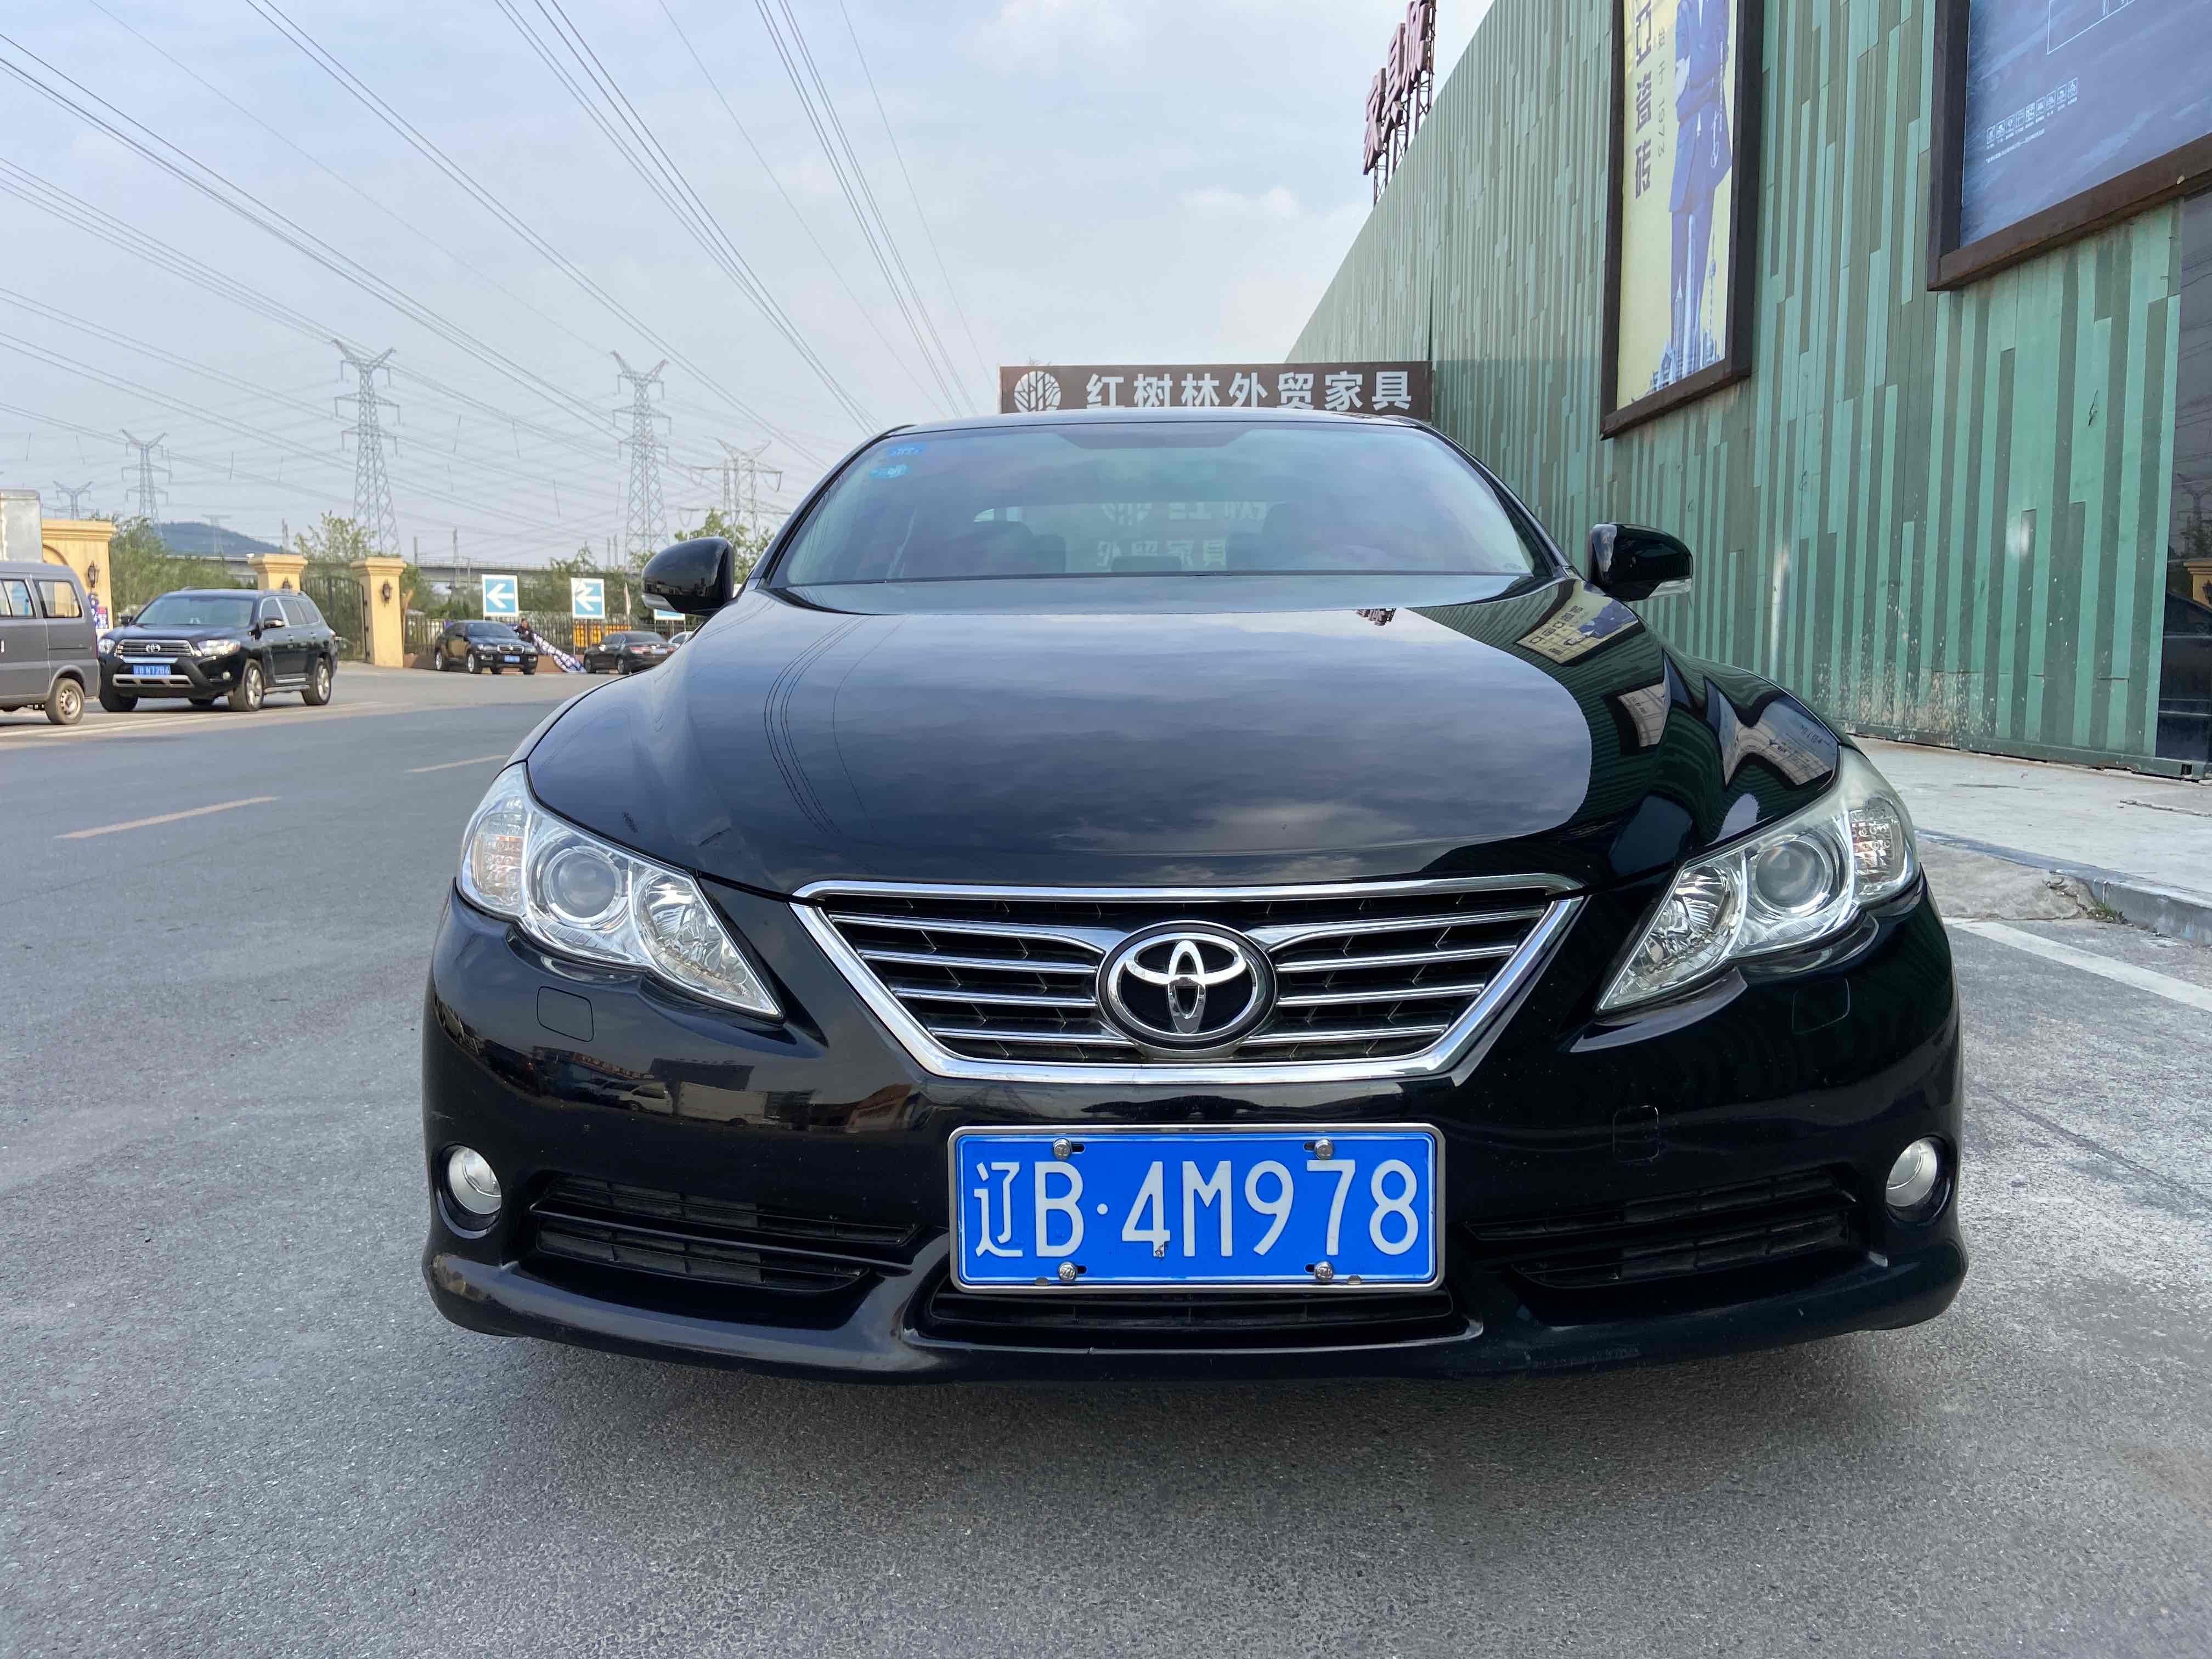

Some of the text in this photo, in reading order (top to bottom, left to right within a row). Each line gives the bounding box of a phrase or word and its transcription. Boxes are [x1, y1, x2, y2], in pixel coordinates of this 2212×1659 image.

[1085, 371, 1412, 411] 红树林外贸家具
[974, 1159, 1420, 1258] 辽B·4M978
